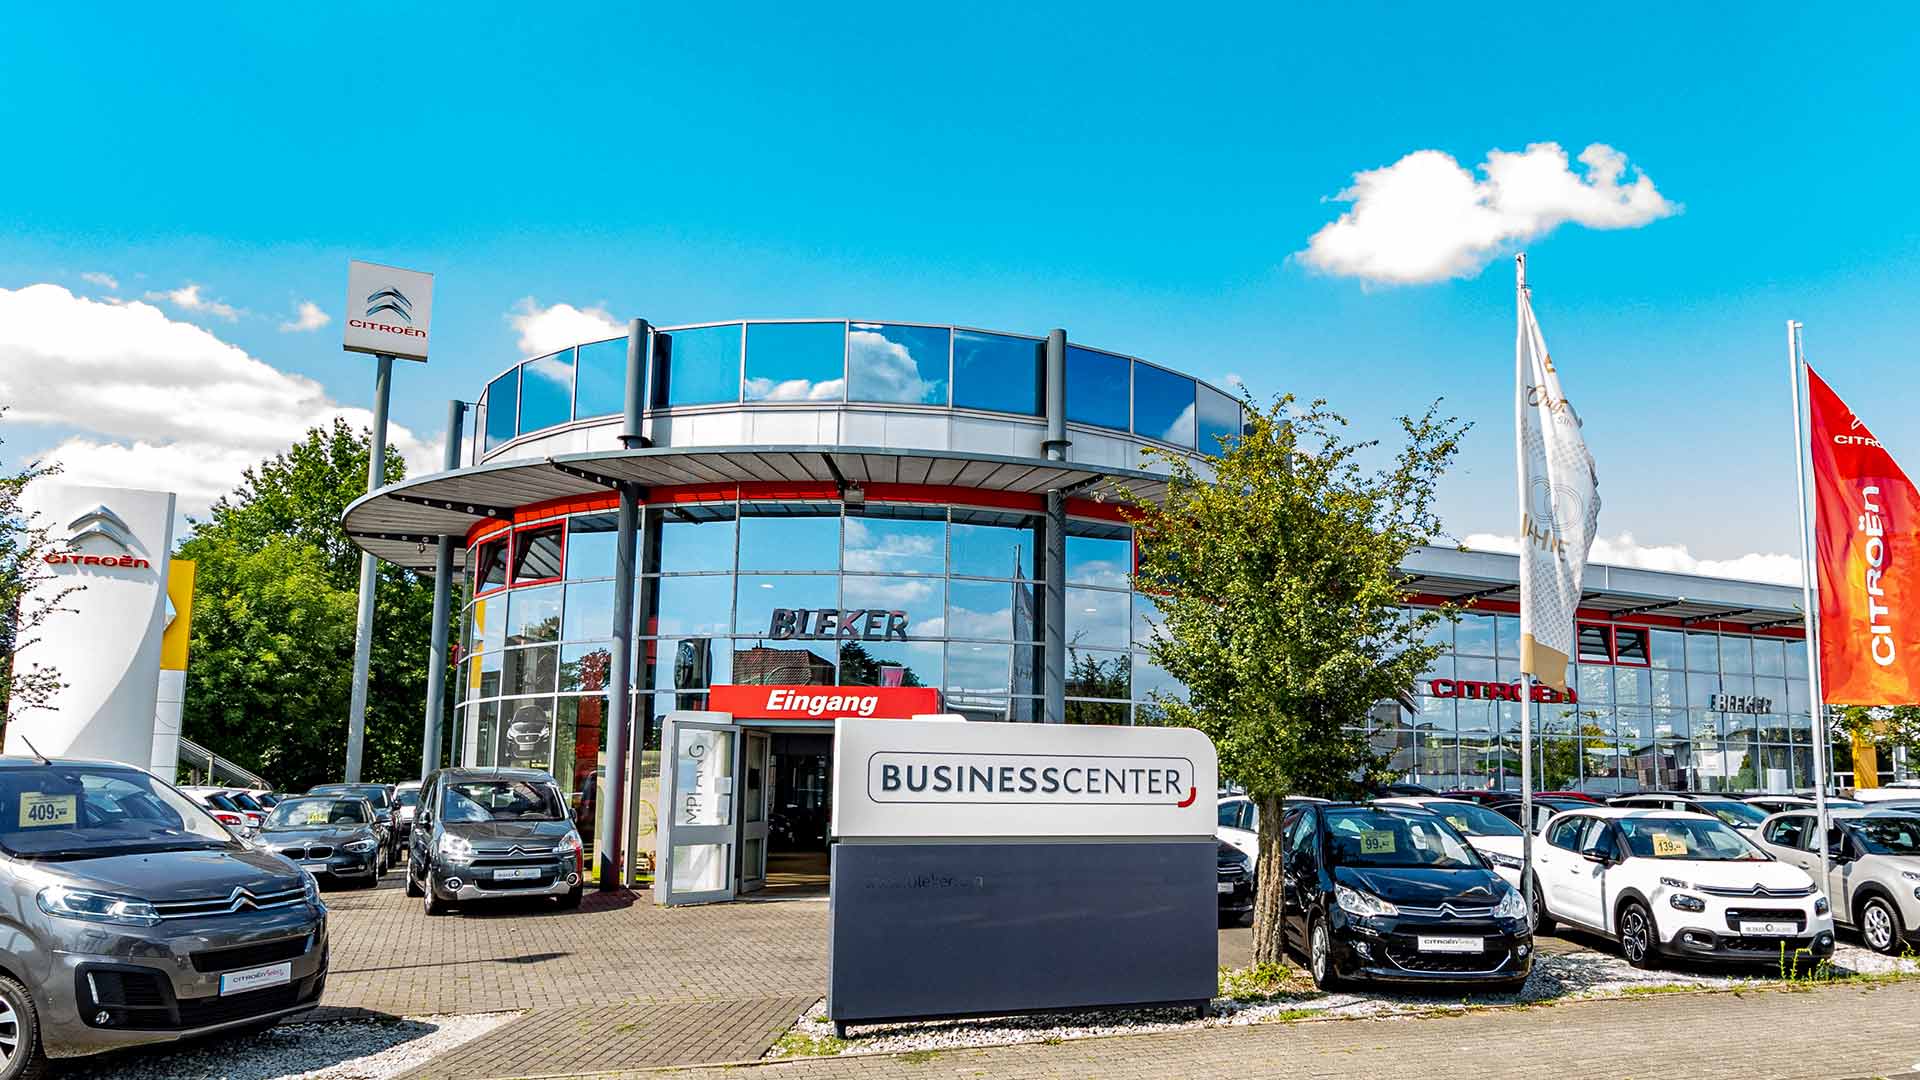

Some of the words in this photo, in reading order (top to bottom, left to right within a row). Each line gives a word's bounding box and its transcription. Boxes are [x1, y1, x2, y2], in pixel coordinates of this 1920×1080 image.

[769, 608, 910, 642] BLEKER
[766, 689, 879, 717] Eingang
[881, 764, 1183, 795] BUSINESSCENTER
